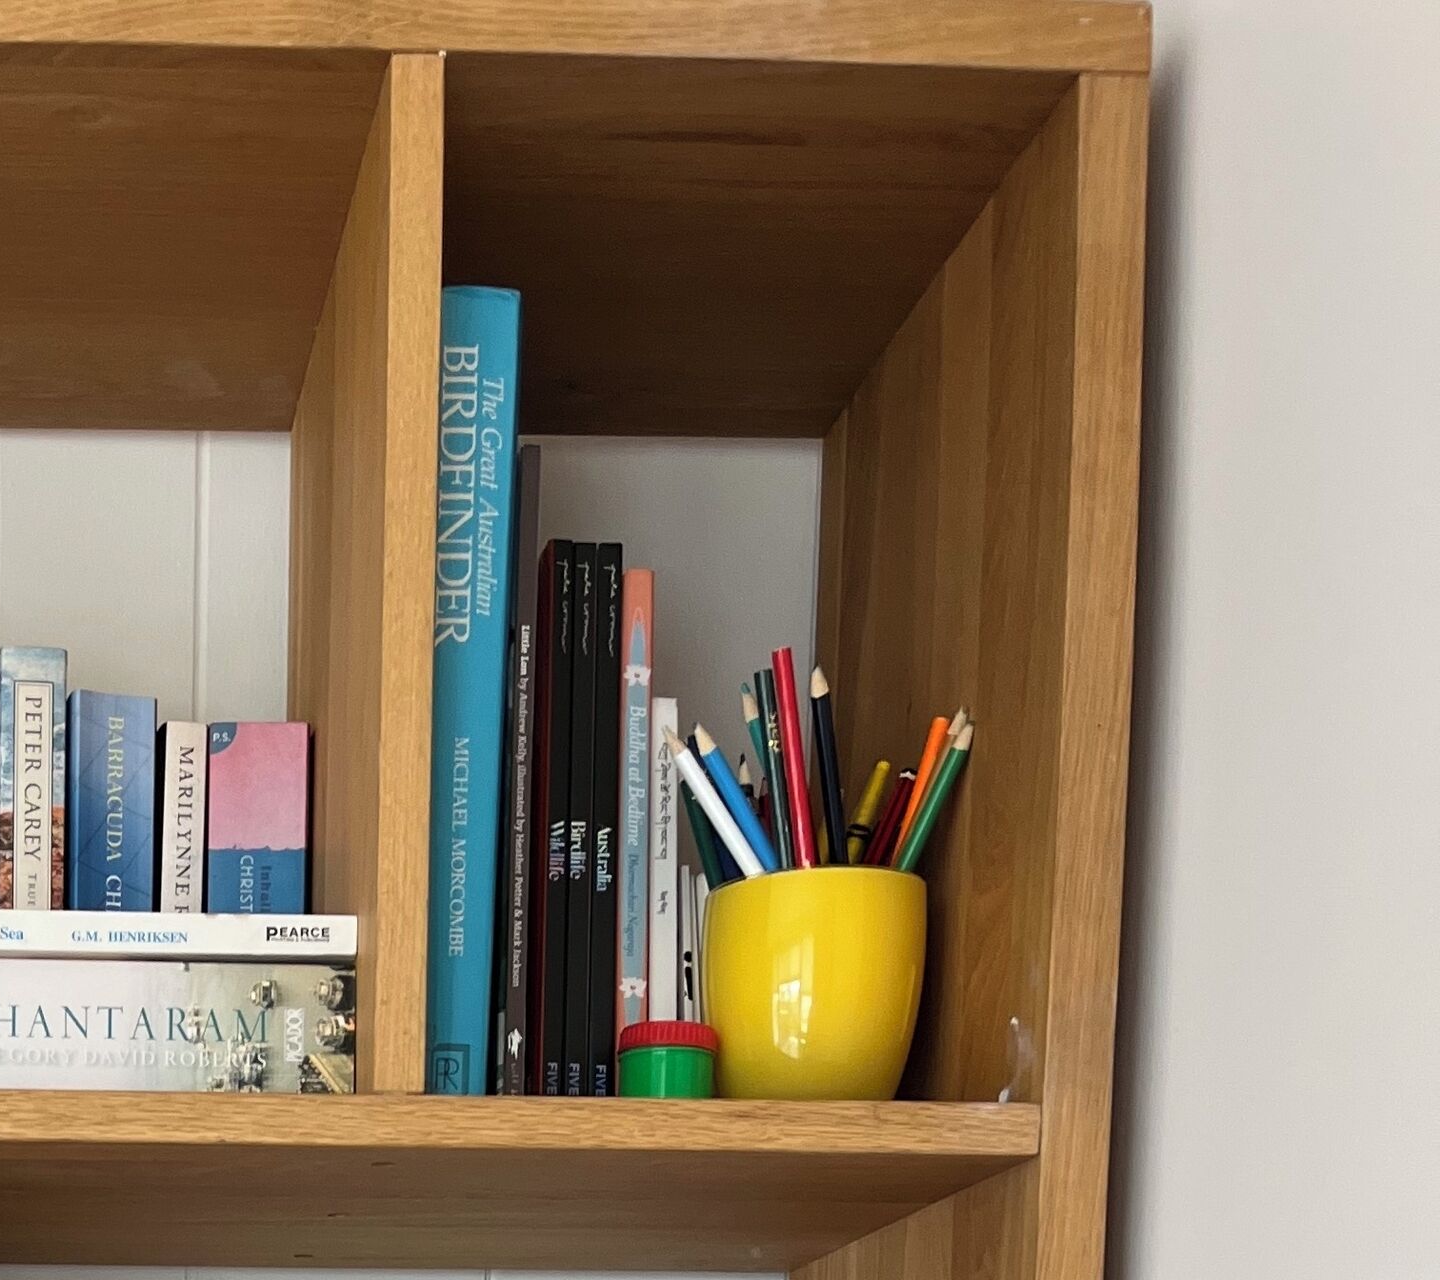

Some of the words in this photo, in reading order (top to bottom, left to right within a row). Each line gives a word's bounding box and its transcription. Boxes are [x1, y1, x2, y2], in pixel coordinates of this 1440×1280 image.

[482, 377, 504, 420] The
[480, 427, 502, 490] Great
[435, 344, 479, 647] BIRDFINDER
[477, 498, 500, 617] Australian
[24, 695, 43, 774] PETER
[629, 705, 647, 764] Buddha
[107, 715, 125, 863] BARRACUDA
[452, 736, 471, 831] MICHAEL
[629, 767, 639, 784] at
[24, 782, 43, 861] CAREY
[176, 745, 195, 897] MARILYNNE
[569, 821, 586, 880] Birdlife
[628, 786, 646, 847] Bedtime
[596, 825, 613, 892] Australia
[0, 925, 25, 941] Sea
[71, 930, 102, 942] G.M.
[107, 930, 189, 943] HENRIKSEN
[266, 925, 331, 941] PEARCE
[448, 838, 467, 958] MORCOMBE
